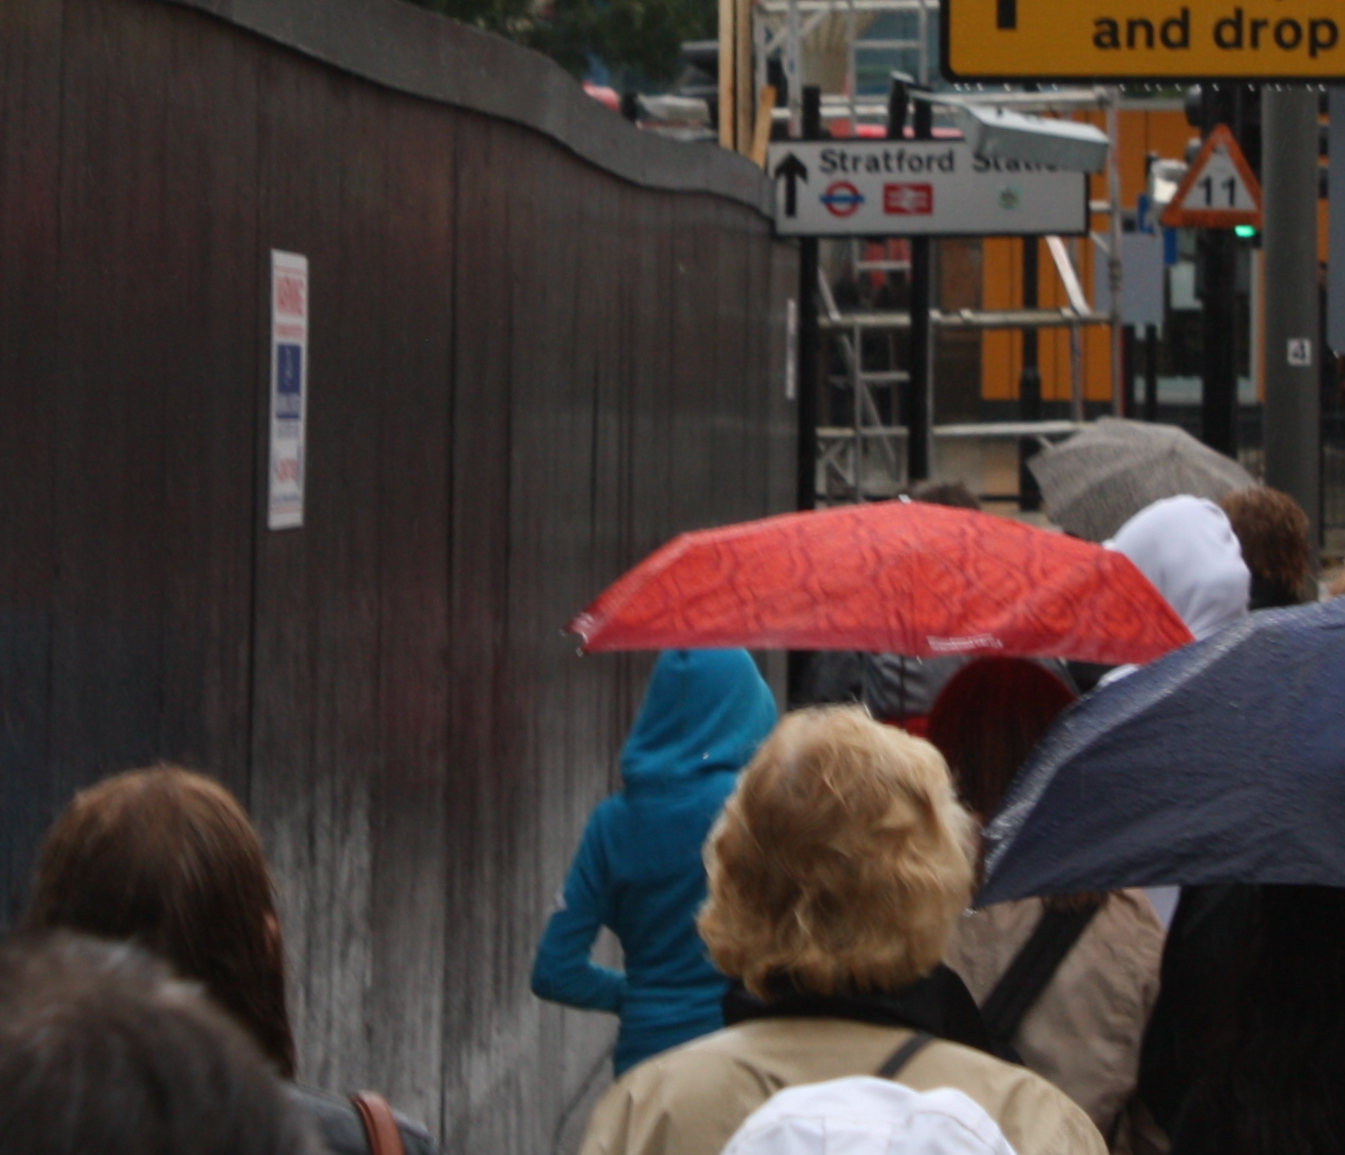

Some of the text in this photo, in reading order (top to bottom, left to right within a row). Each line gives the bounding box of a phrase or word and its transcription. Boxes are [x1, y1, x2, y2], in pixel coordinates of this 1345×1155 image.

[1092, 8, 1191, 51] and
[1213, 8, 1339, 57] drop
[818, 147, 956, 175] Stratford
